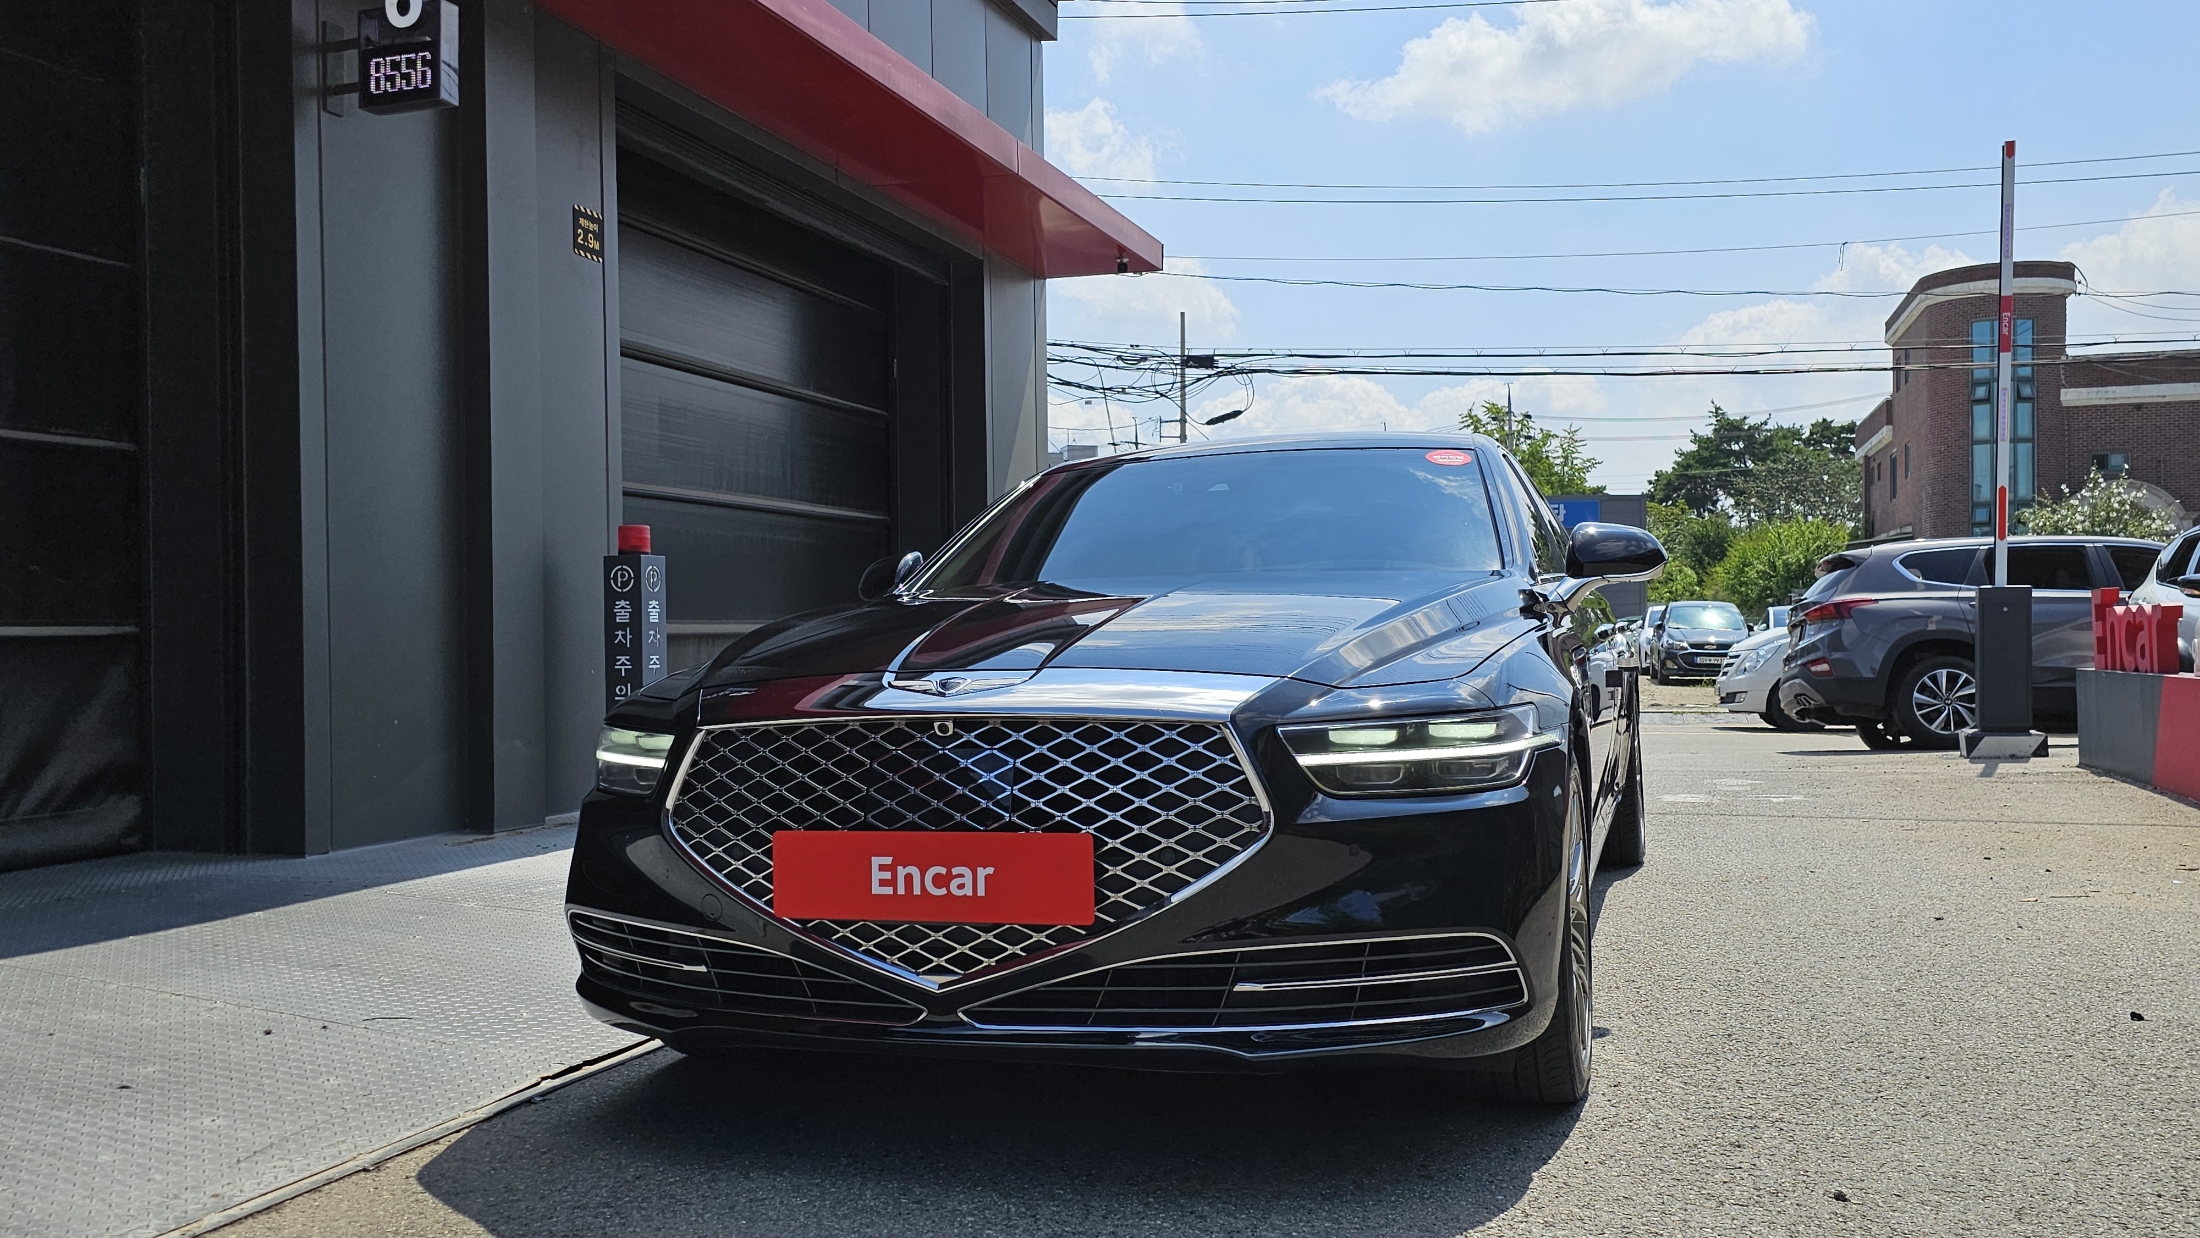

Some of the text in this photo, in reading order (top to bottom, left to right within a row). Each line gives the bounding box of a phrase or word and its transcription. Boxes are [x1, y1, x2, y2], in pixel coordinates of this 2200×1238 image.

[369, 51, 432, 94] 8556
[577, 229, 600, 251] 2.9M
[2091, 587, 2168, 674] Encar
[870, 856, 995, 897] Encar
